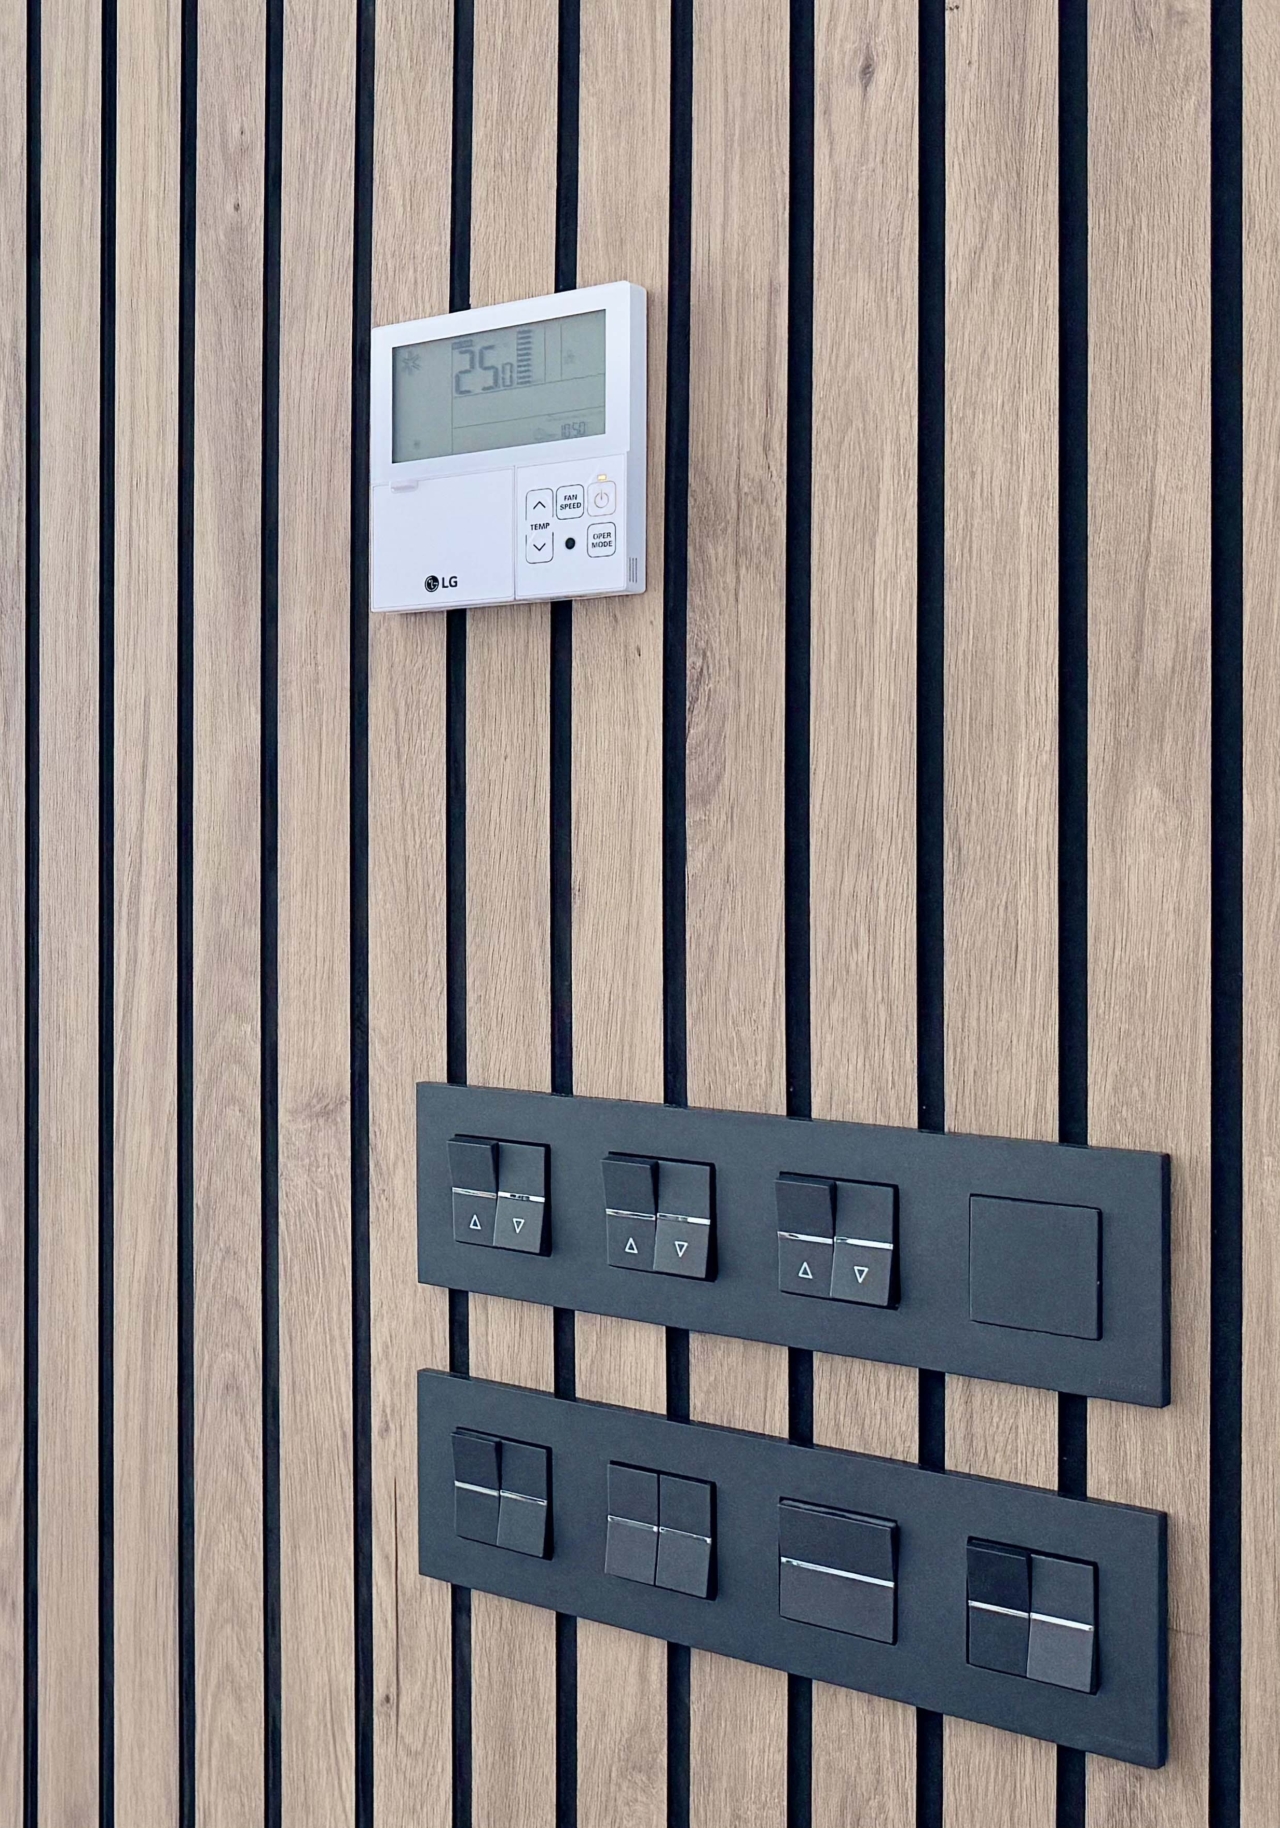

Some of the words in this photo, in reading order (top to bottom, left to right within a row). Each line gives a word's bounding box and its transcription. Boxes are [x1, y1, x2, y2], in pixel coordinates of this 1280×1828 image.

[563, 494, 578, 502] FAN
[559, 502, 582, 511] SPEED
[530, 522, 550, 531] TEMP
[592, 532, 612, 540] OPER
[591, 540, 613, 549] MODE
[441, 575, 458, 589] LG
